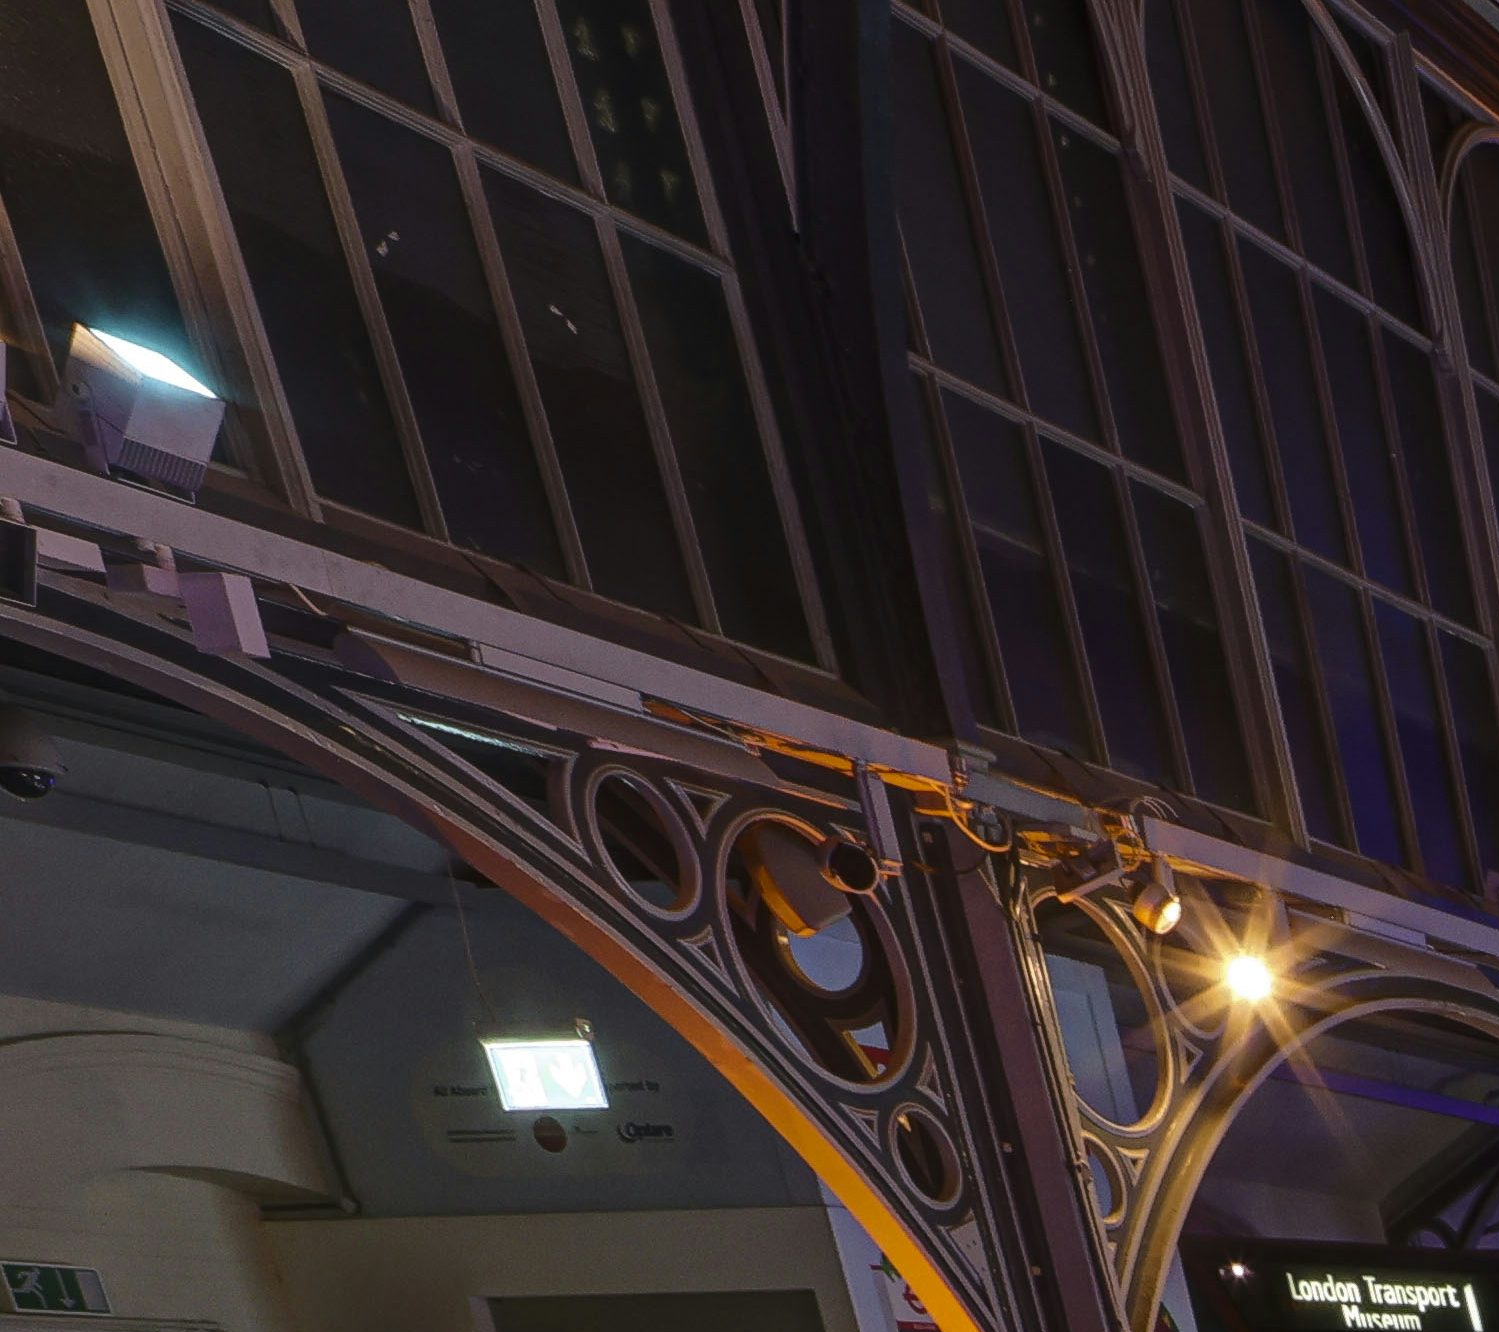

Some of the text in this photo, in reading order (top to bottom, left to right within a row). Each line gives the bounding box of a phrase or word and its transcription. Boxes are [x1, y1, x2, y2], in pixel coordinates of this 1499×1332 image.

[1286, 1272, 1461, 1313] London Transport
[1341, 1304, 1424, 1331] Museum
